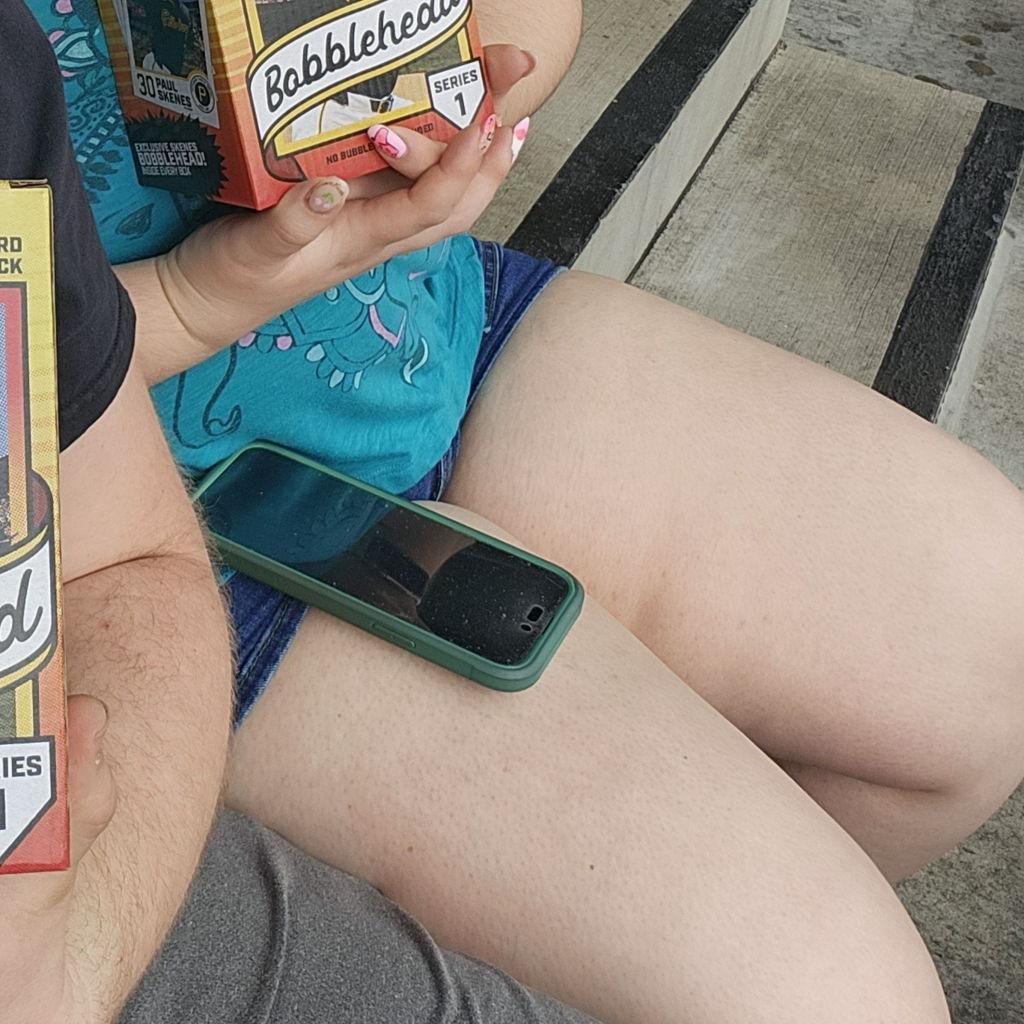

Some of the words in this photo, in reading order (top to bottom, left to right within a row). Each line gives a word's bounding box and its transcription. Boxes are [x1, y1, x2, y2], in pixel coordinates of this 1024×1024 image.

[137, 73, 156, 97] 30
[155, 77, 179, 93] PAUL
[433, 69, 478, 94] SERIES
[157, 88, 193, 108] SKENES
[454, 91, 466, 116] 1
[137, 151, 207, 166] BOBBLEHEAD!
[326, 154, 339, 165] NO
[340, 143, 376, 160] BUBBLE
